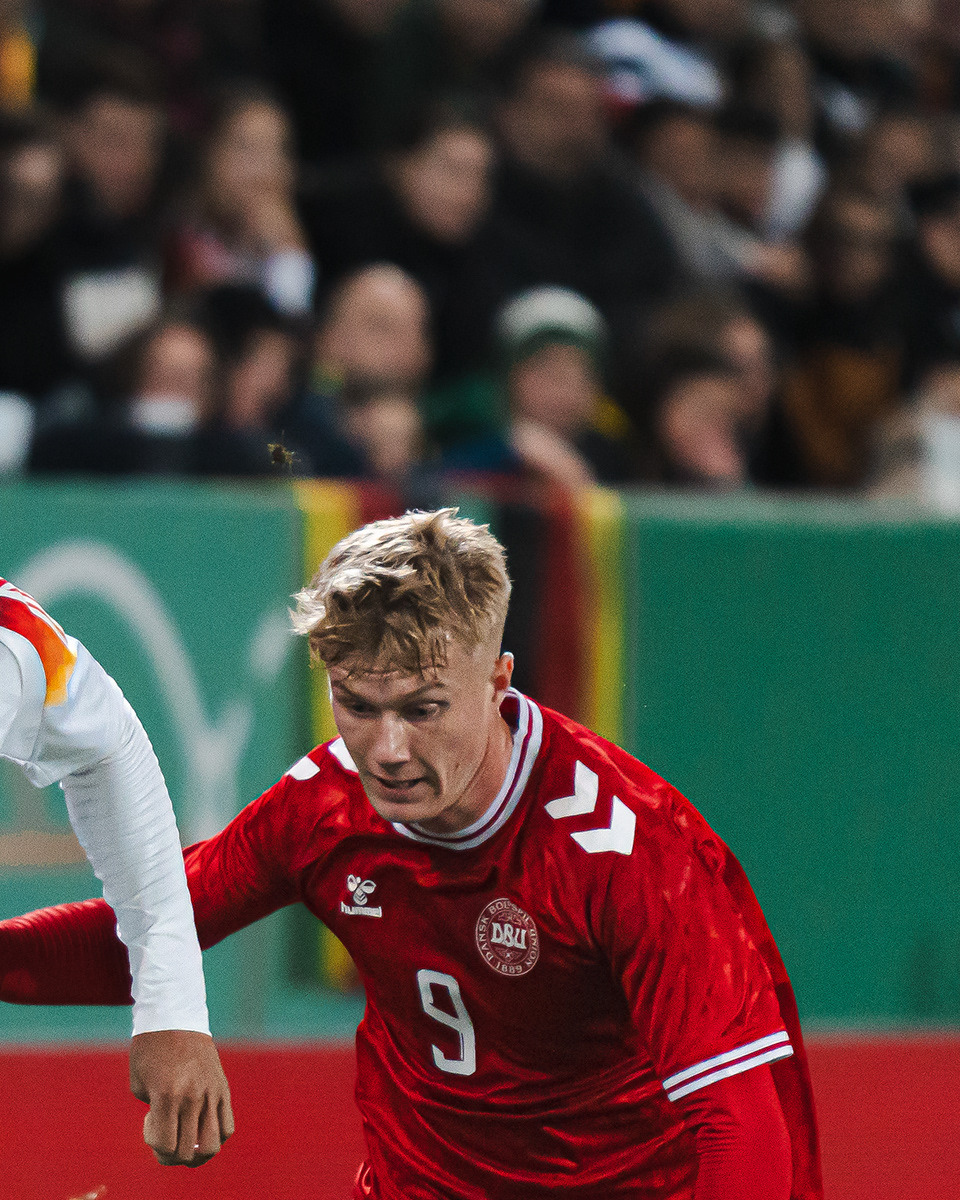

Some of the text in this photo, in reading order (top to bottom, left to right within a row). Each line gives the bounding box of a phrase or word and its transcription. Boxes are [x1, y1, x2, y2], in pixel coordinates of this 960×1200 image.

[491, 922, 527, 950] DBU
[496, 961, 523, 974] 1889
[416, 968, 476, 1076] 9
